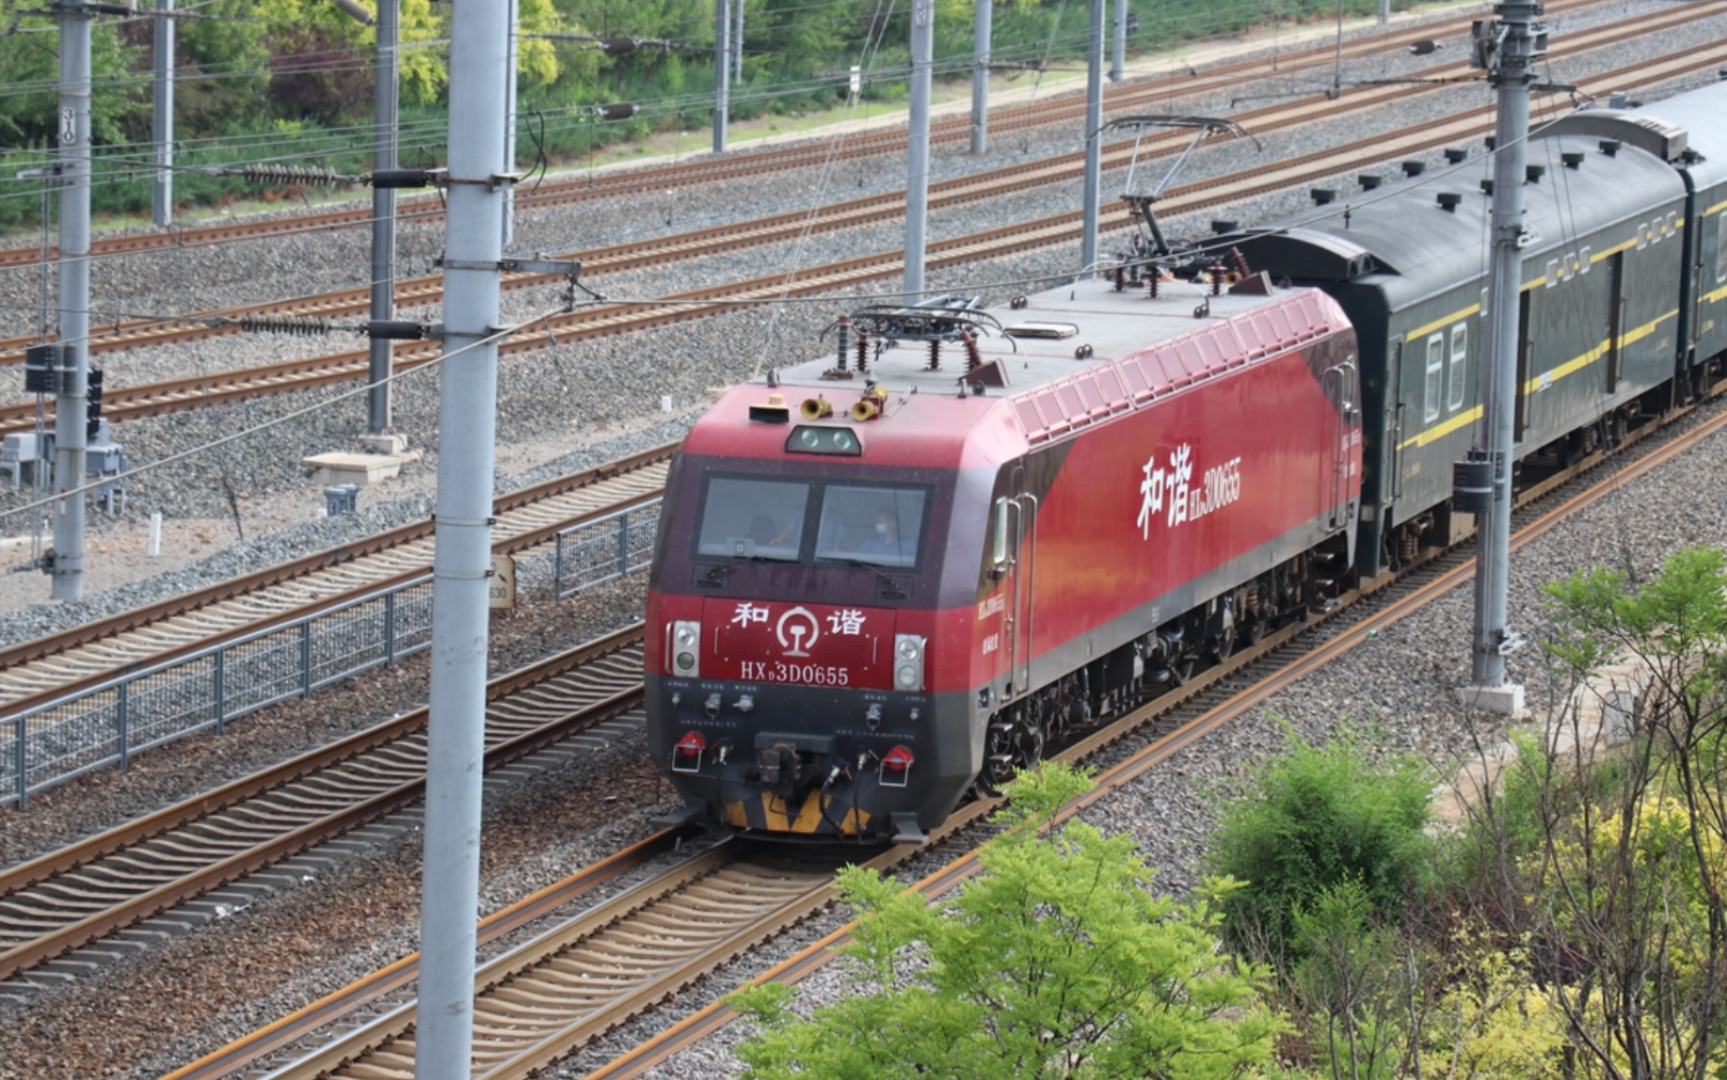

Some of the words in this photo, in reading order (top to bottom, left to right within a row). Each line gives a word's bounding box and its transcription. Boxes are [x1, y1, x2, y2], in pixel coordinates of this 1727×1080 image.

[63, 108, 73, 141] 310
[1137, 442, 1192, 541] 和谐
[731, 602, 769, 628] 和
[827, 609, 866, 635] 谐
[741, 661, 849, 685] HXD3D0655
